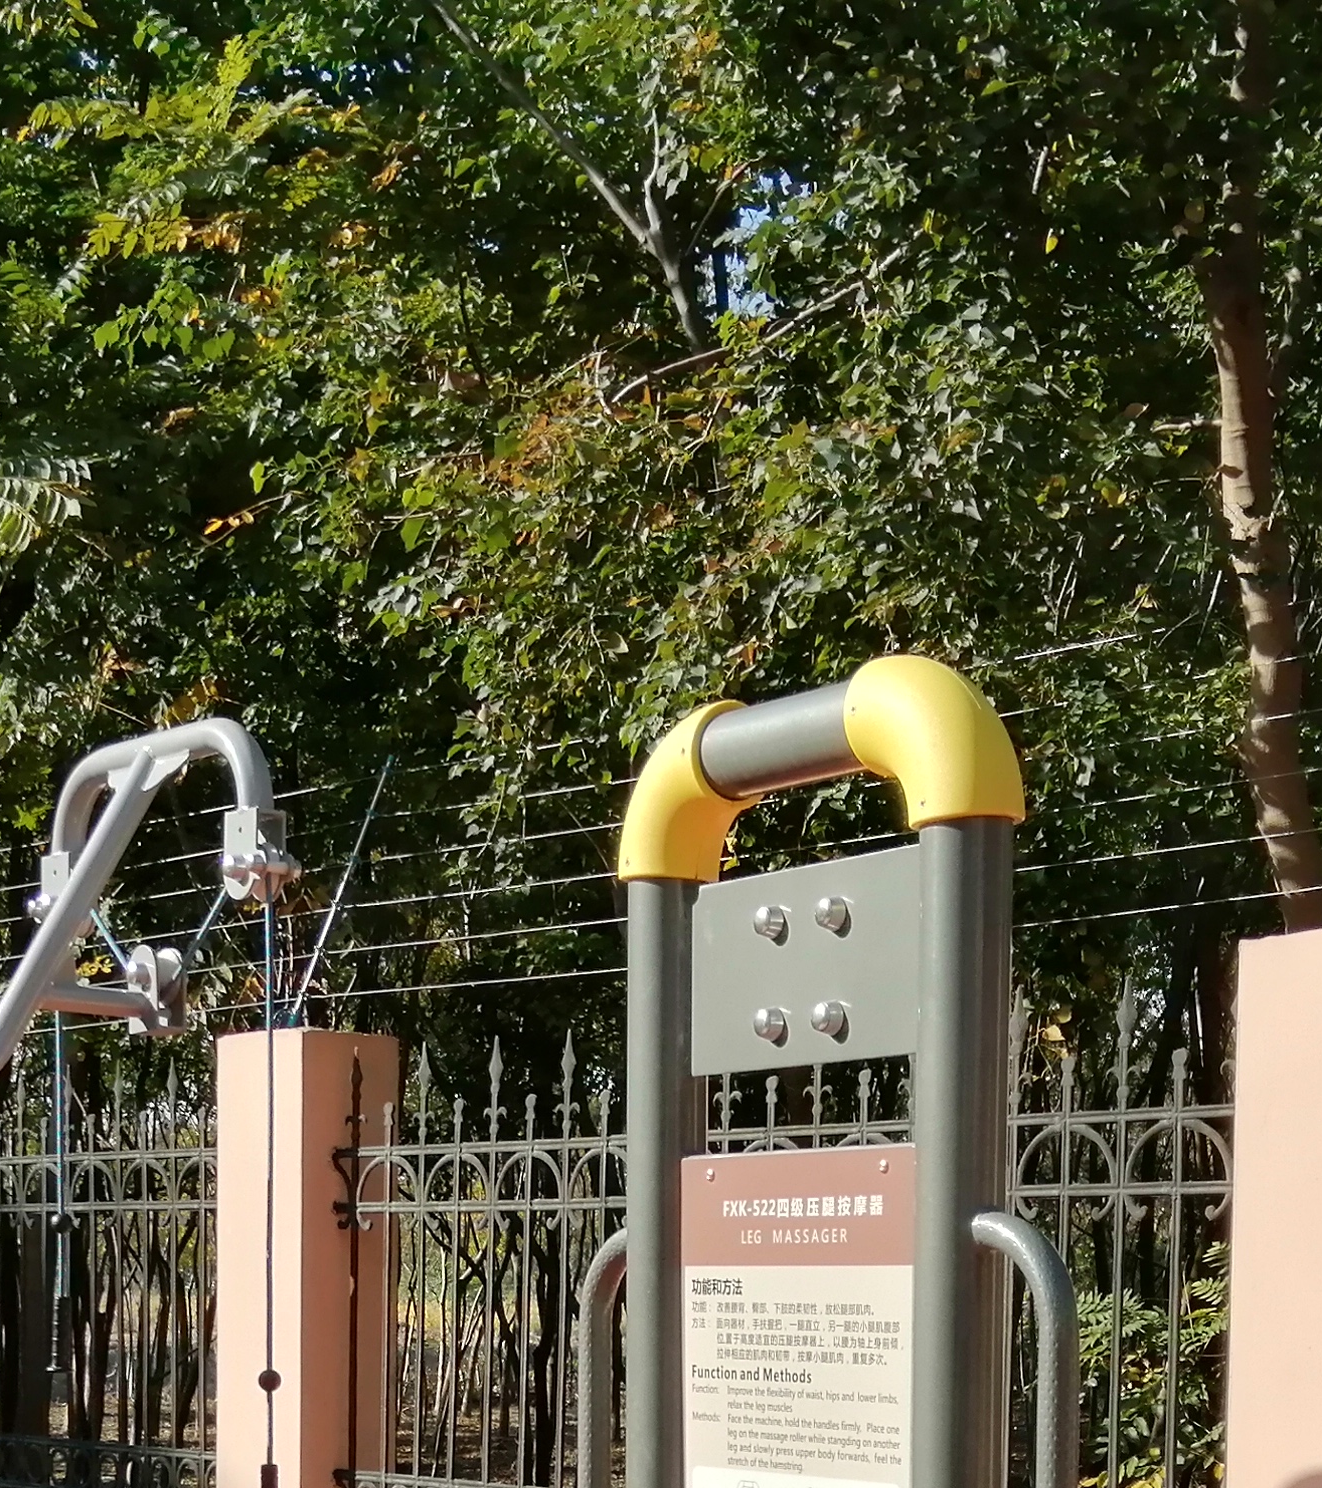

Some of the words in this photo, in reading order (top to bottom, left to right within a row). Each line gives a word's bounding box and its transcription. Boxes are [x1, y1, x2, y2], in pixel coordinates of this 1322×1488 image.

[723, 1195, 883, 1218] FXK-522四级压腿按摩器
[741, 1229, 762, 1244] LEG
[773, 1228, 848, 1243] MASSAGER
[692, 1278, 743, 1295] 功能和方法
[692, 1365, 737, 1380] Function
[740, 1367, 760, 1381] and
[763, 1368, 812, 1384] Methods
[727, 1386, 753, 1397] Improve
[755, 1386, 765, 1397] the
[767, 1387, 796, 1401] flexibility
[797, 1389, 805, 1399] of
[806, 1389, 824, 1401] waist,
[826, 1390, 839, 1403] hips
[841, 1392, 854, 1402] and
[857, 1392, 876, 1403] lower
[727, 1400, 742, 1410] relax
[743, 1400, 754, 1410] the
[756, 1401, 765, 1413] leg
[767, 1402, 793, 1413] muscles
[728, 1413, 742, 1424] Face
[743, 1414, 754, 1424] the
[755, 1416, 783, 1427] machine,
[785, 1417, 799, 1428] hold
[801, 1418, 812, 1428] the
[814, 1419, 839, 1431] handles
[866, 1423, 884, 1434] Place
[886, 1425, 899, 1435] one
[727, 1428, 737, 1440] leg
[739, 1430, 747, 1438] on
[748, 1429, 759, 1439] the
[760, 1431, 788, 1444] massage
[790, 1432, 807, 1442] roller
[808, 1434, 826, 1444] while
[862, 1439, 872, 1447] on
[873, 1439, 900, 1450] another
[727, 1441, 737, 1454] leg
[739, 1443, 751, 1452] and
[753, 1443, 774, 1456] slowly
[776, 1447, 794, 1456] press
[795, 1448, 816, 1459] upper
[817, 1448, 835, 1462] body
[874, 1453, 888, 1464] feel
[889, 1455, 902, 1465] the
[727, 1456, 749, 1466] stretch
[750, 1457, 757, 1467] of
[758, 1458, 769, 1468] the
